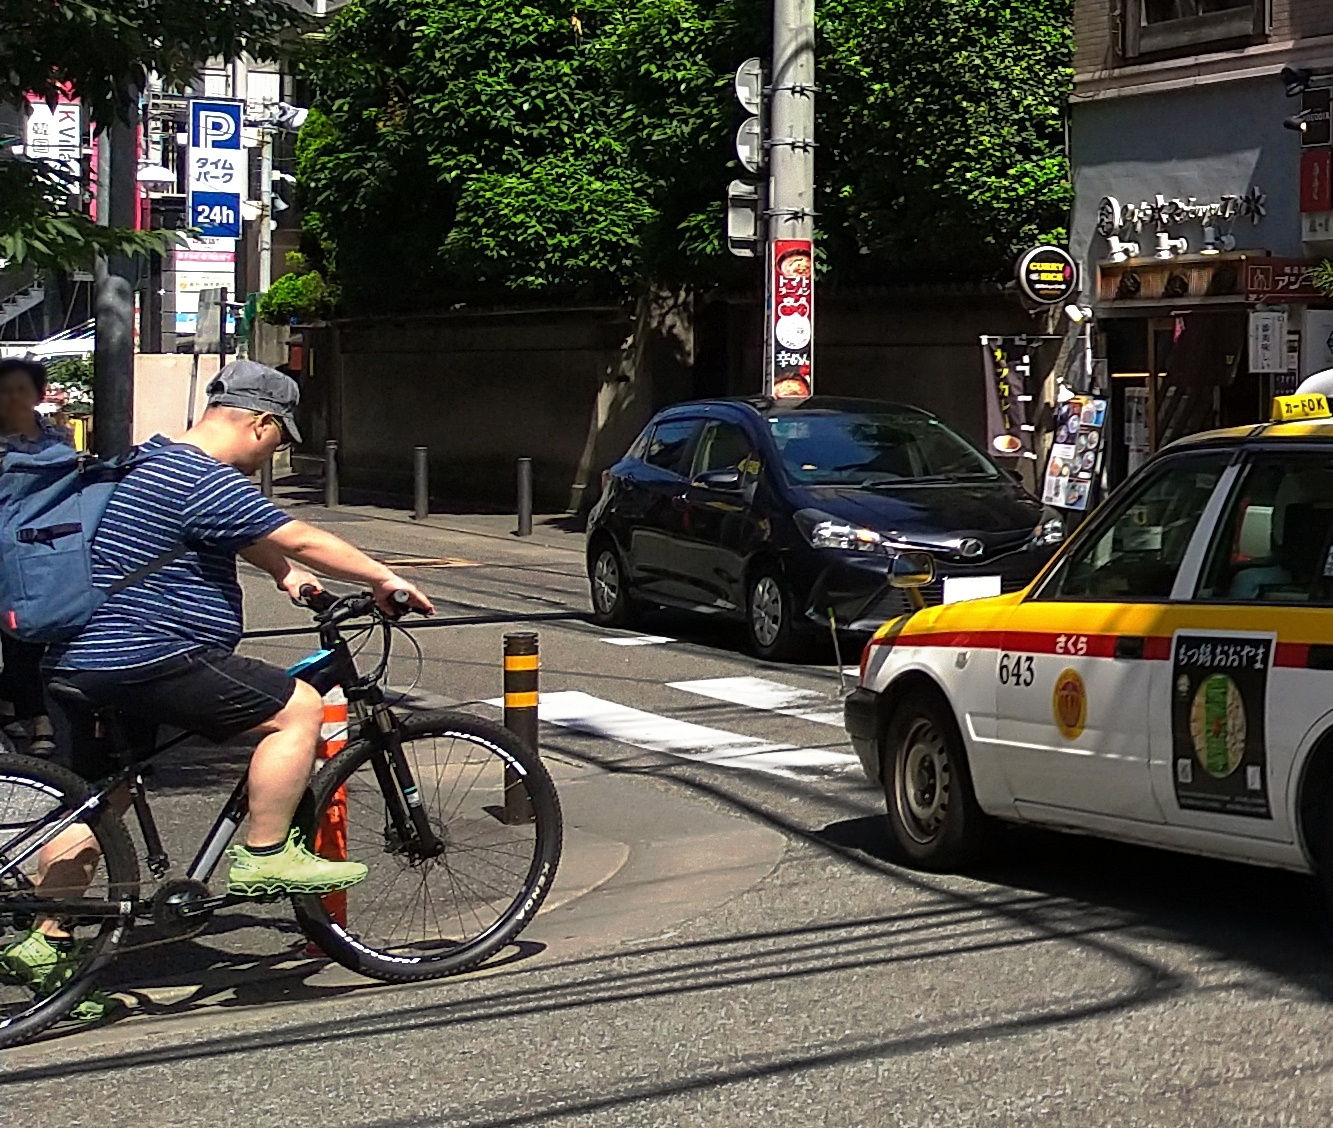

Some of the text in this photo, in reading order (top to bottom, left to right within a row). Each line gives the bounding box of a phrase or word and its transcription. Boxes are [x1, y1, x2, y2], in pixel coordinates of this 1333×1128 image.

[196, 157, 234, 171] タイム
[196, 171, 234, 184] パーク
[197, 205, 235, 224] 24h
[1055, 634, 1088, 655] さくら
[1000, 653, 1035, 687] 643
[515, 861, 550, 920] KENDA
